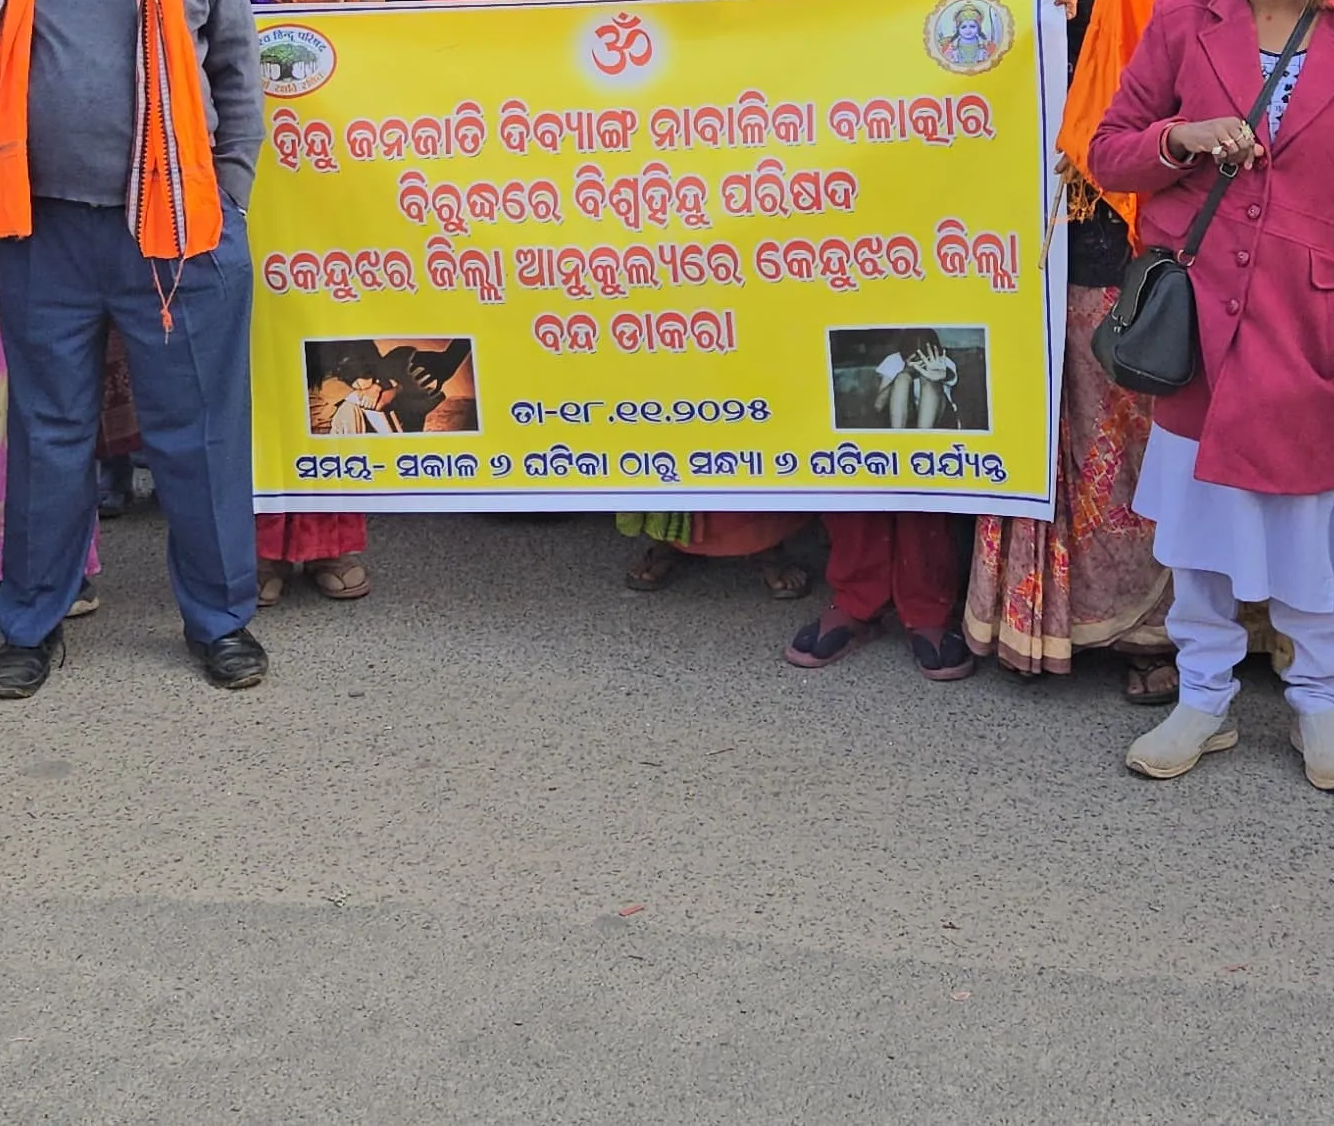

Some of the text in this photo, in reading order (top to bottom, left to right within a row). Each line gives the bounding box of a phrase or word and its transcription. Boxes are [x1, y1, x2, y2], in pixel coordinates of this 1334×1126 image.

[271, 88, 997, 173] ହିନ୍ଦୁ ଜନଜାତି ଦିବ୍ୟାଙ୍ଗ ନାବାଳିକା ବଳାତ୍କାର
[398, 171, 564, 236] ବିରୁଦ୍ଧରେ
[720, 157, 860, 218] ପରିଷଦ
[262, 249, 418, 303] କେନ୍ଦୁଝର
[426, 234, 506, 304] ଜିଲ୍ଲା
[755, 234, 925, 293] କେନ୍ଦୁଝର
[935, 217, 1021, 293] ଜିଲ୍ଲା
[533, 309, 738, 355] ବନ୍ଦ ଡାକରା
[395, 452, 480, 479] ସକାଳ
[523, 443, 609, 478] ଘଟିକା
[619, 452, 681, 483] ଠାରୁ
[688, 449, 764, 478] ସନ୍ଧ୍ୟା
[810, 441, 900, 478] ଘଟିକା
